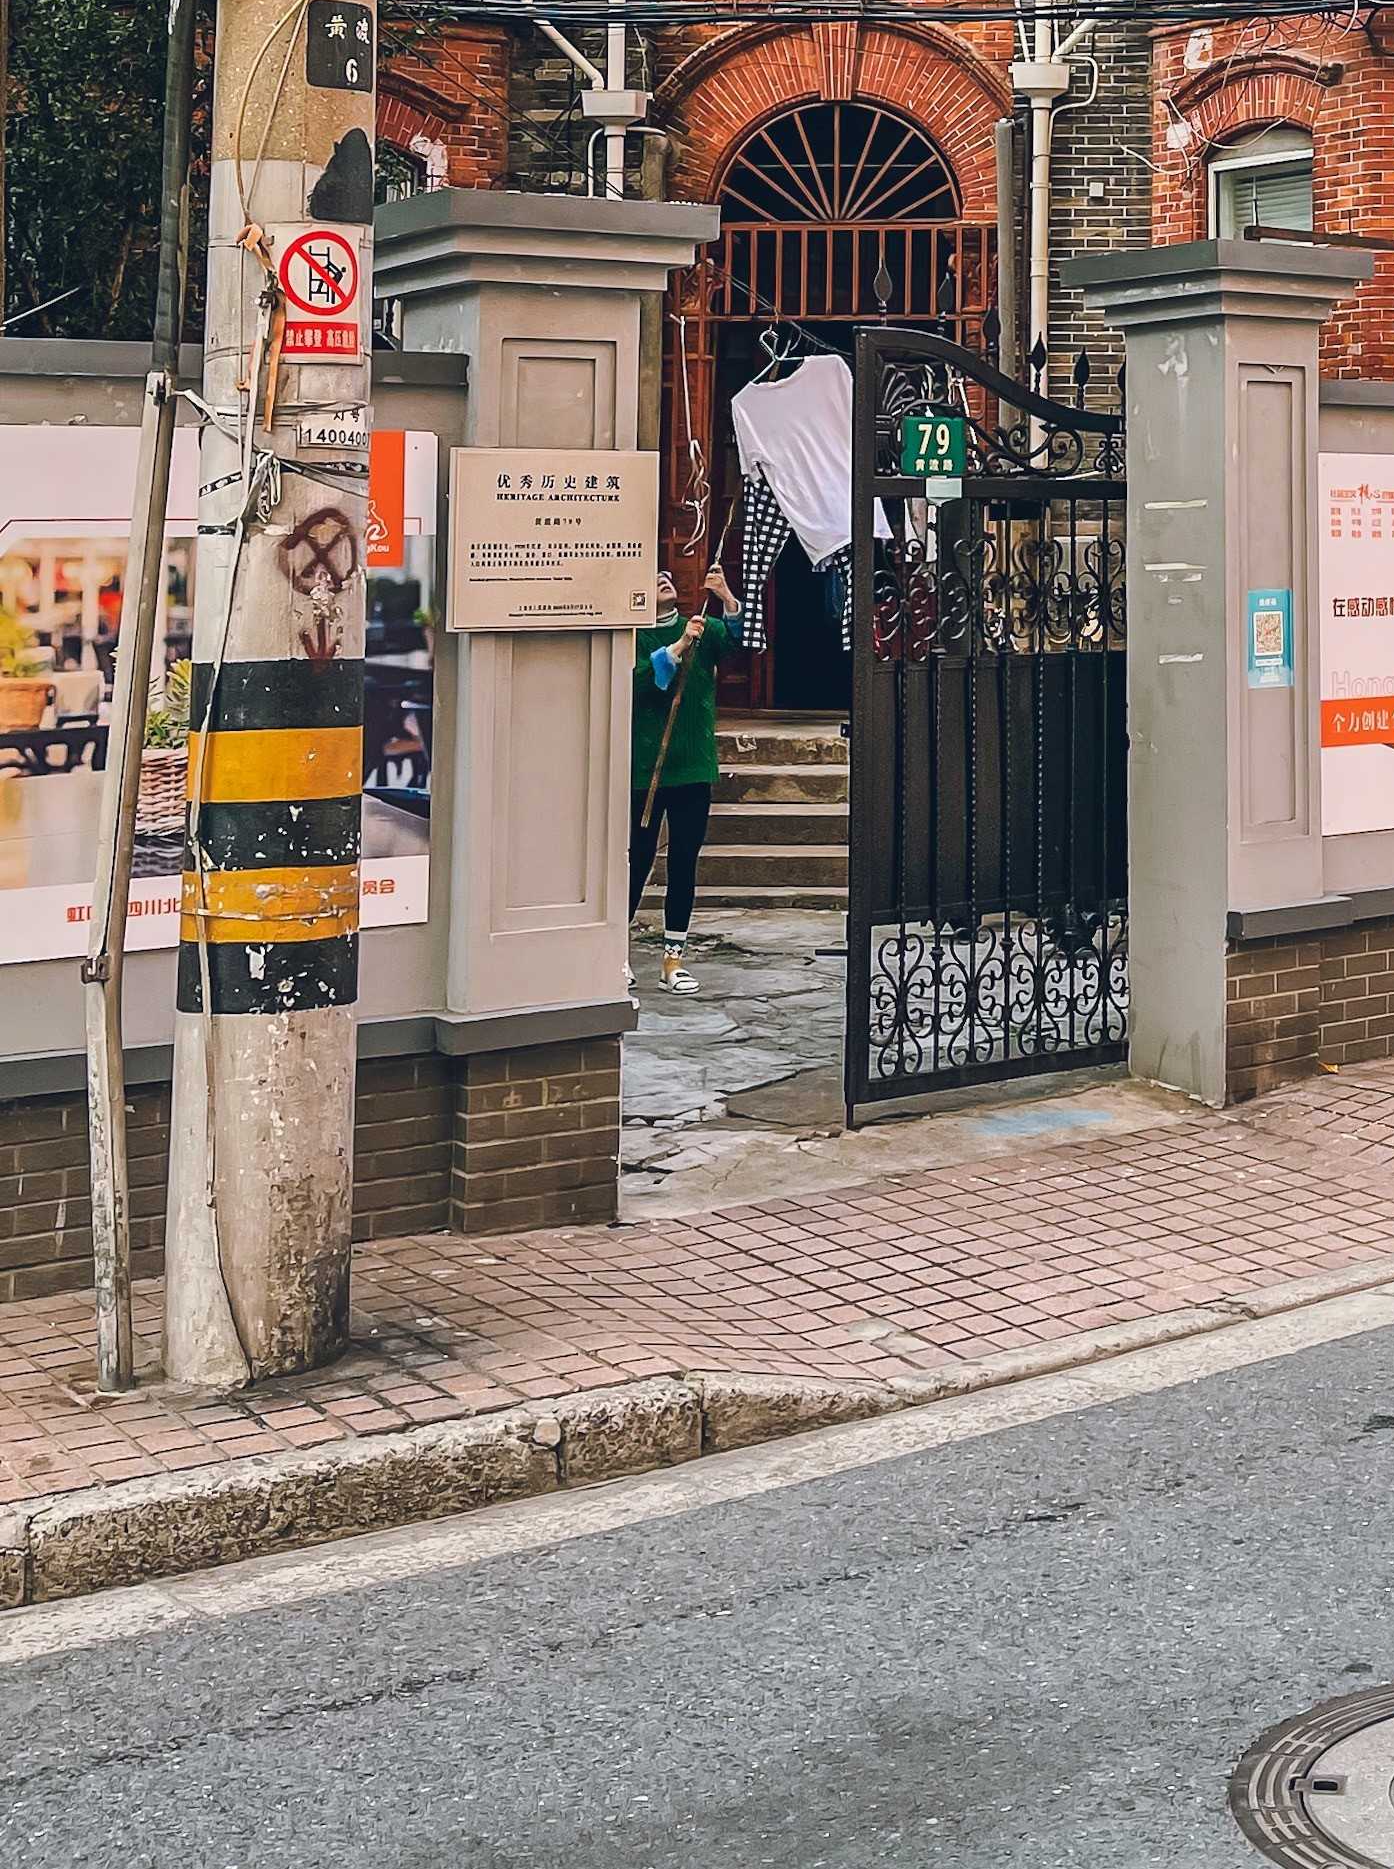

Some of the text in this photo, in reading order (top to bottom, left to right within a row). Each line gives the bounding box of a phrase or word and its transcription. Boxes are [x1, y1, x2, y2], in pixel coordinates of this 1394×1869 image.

[345, 58, 358, 84] 6
[304, 428, 370, 446] 1400400
[918, 423, 950, 455] 79
[496, 474, 621, 490] 优秀历史建筑
[496, 493, 621, 502] HERITAGE ARCHITECTURE
